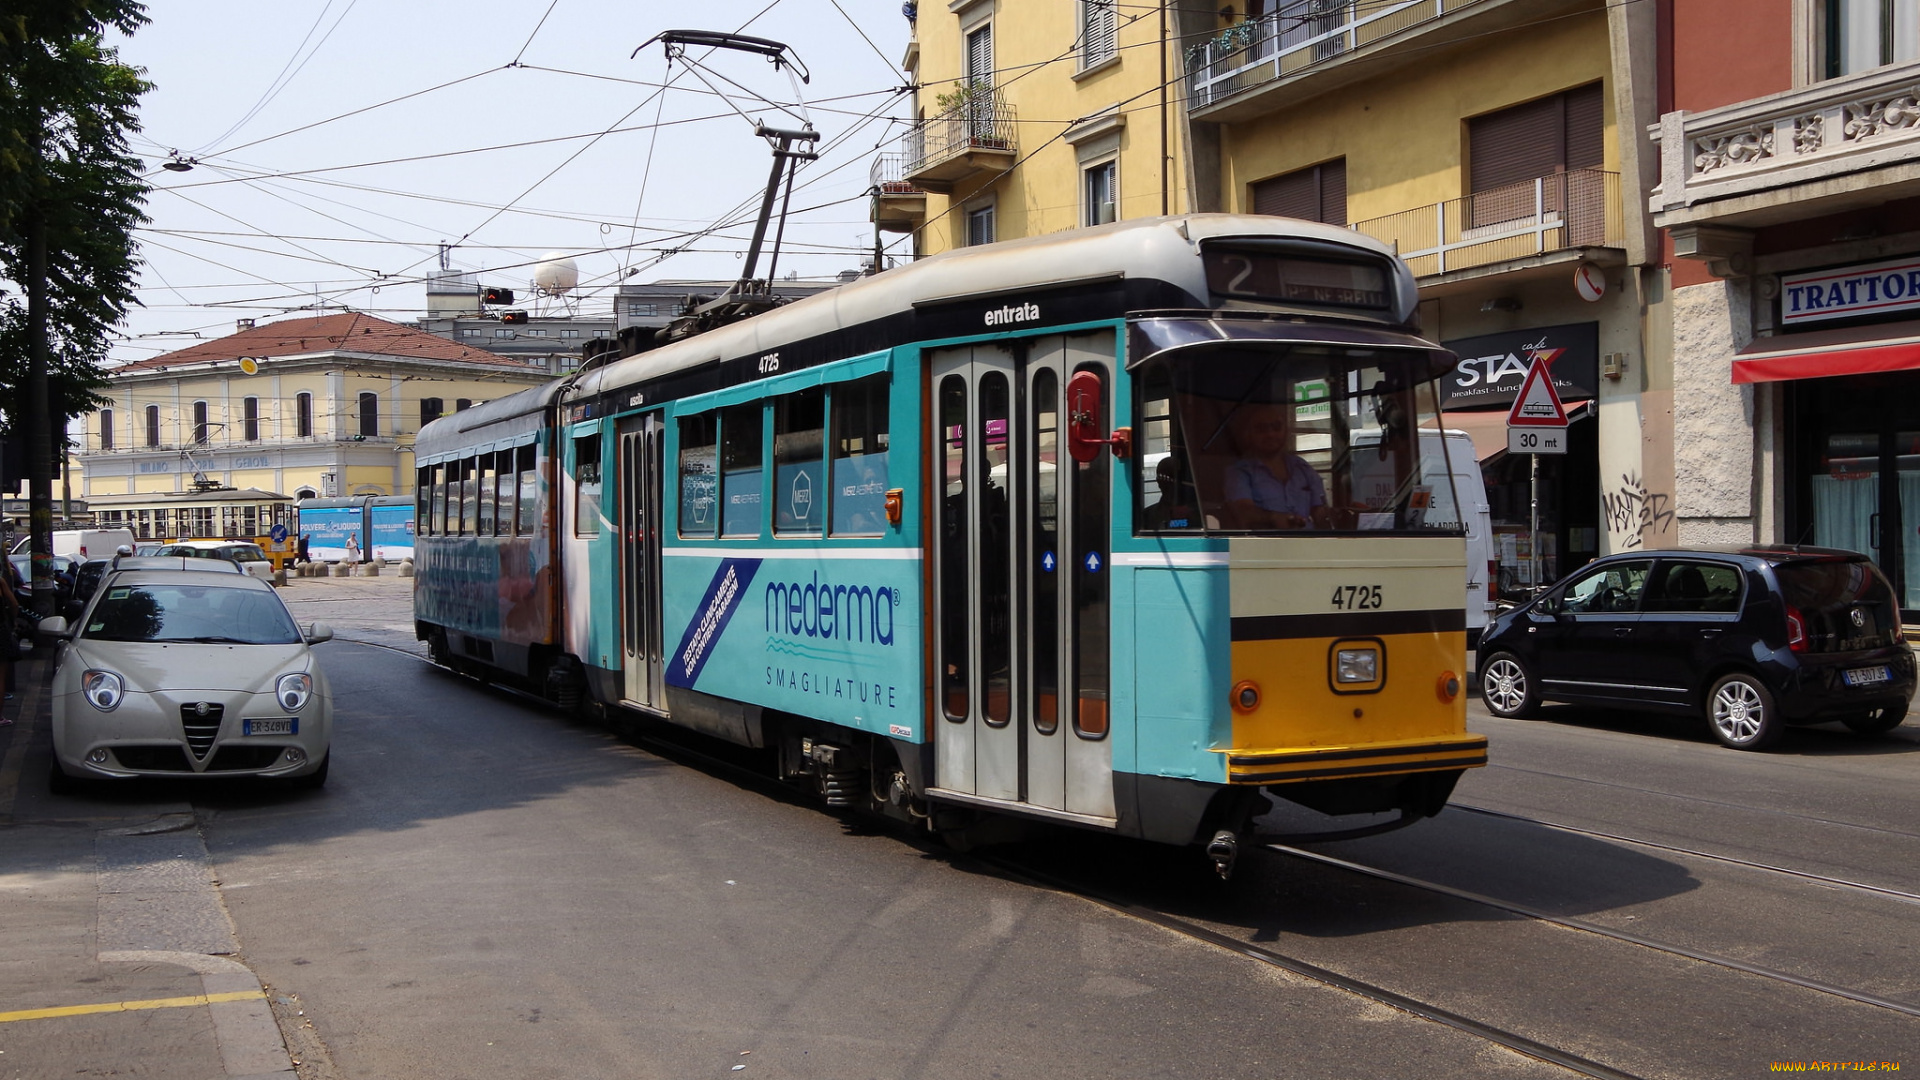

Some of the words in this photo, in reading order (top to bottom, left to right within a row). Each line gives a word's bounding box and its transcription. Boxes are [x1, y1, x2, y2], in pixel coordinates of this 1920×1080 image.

[1222, 253, 1257, 296] 2
[984, 302, 1040, 326] entrata
[758, 352, 779, 373] 4725
[1451, 387, 1489, 398] breakfast
[1520, 433, 1538, 448] 30
[1544, 437, 1557, 448] mt
[140, 462, 168, 473] MILANO
[235, 456, 270, 469] GENOVA
[300, 523, 326, 532] POLVERE
[337, 522, 361, 531] LIQUIDO
[1331, 585, 1382, 609] 4725
[682, 627, 702, 666] TESTATO
[700, 564, 736, 632] CLINICAMENTE
[685, 660, 697, 679] NON
[694, 617, 717, 660] CONTIENE
[715, 578, 739, 623] PARABENI
[766, 666, 895, 708] SMAGLIATURE
